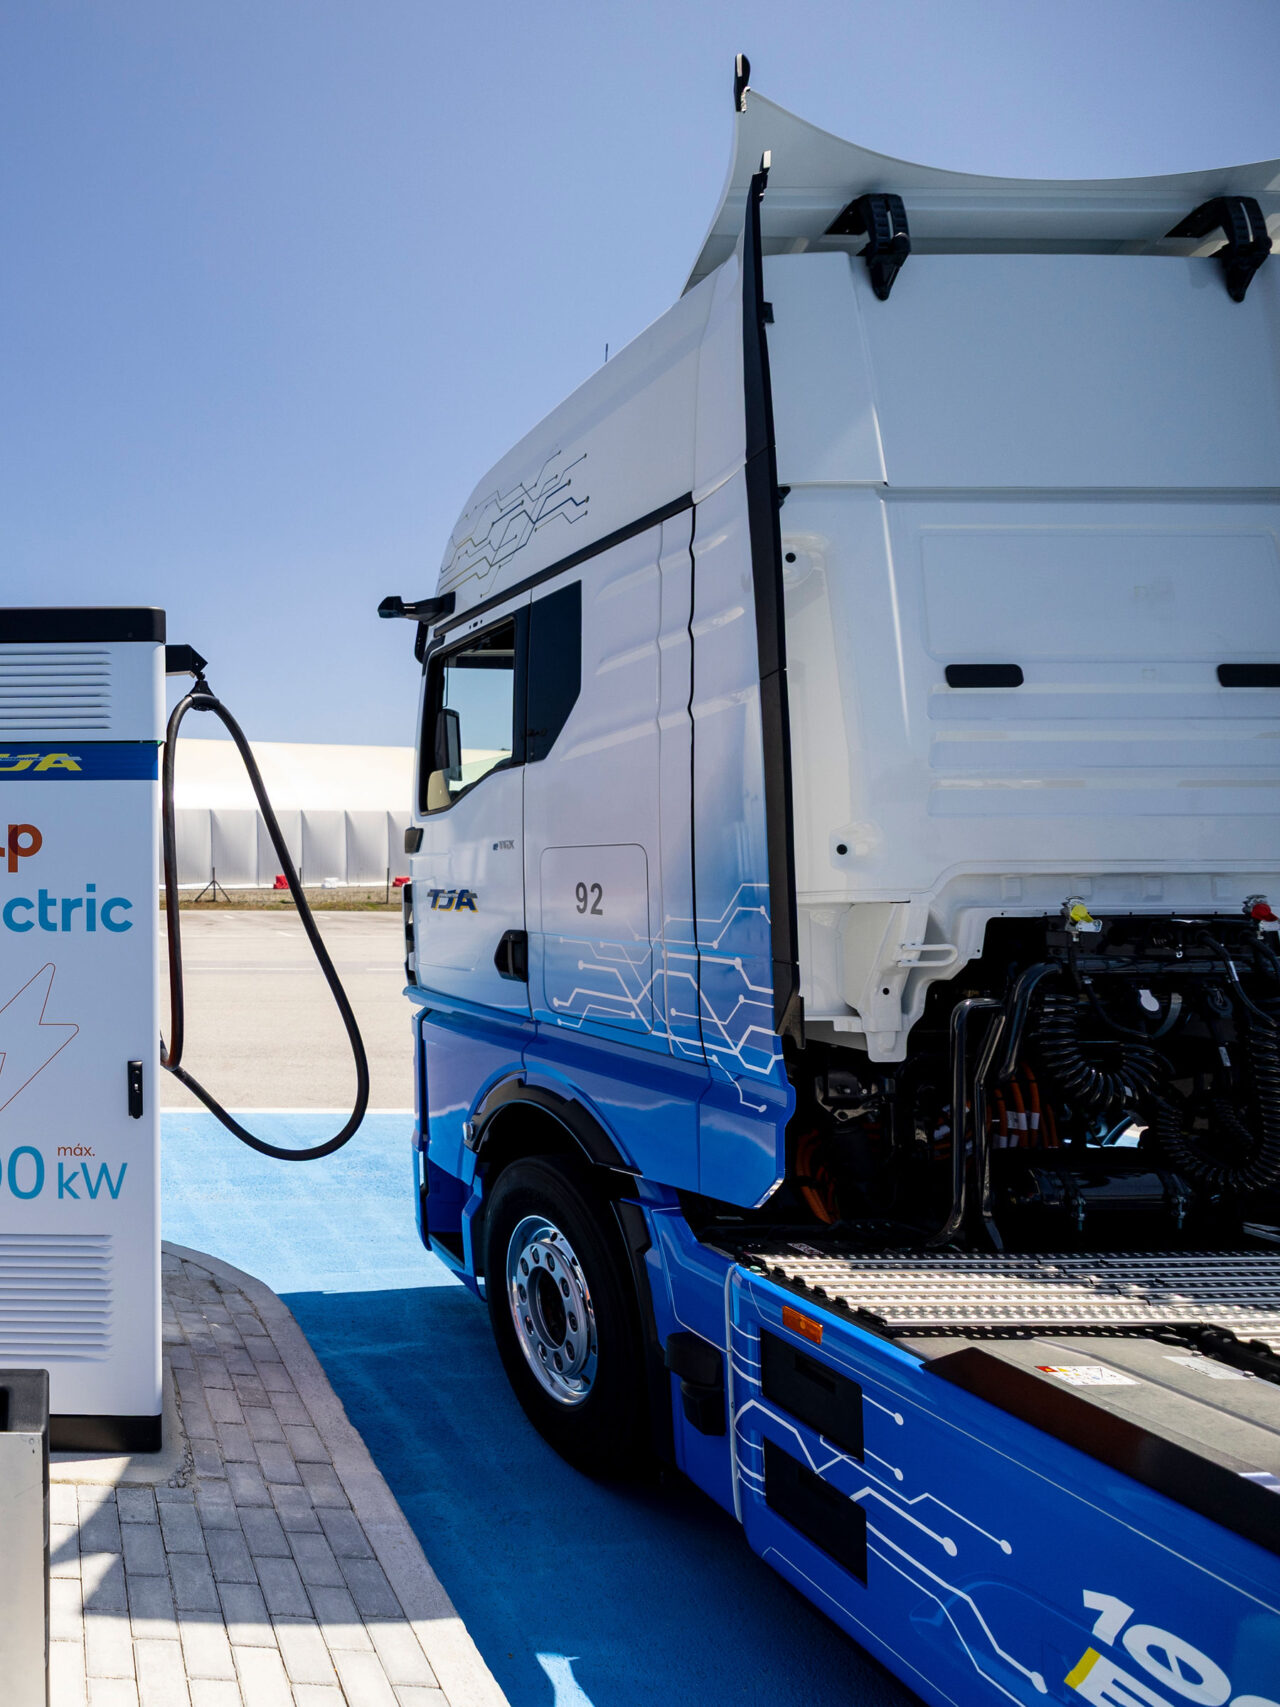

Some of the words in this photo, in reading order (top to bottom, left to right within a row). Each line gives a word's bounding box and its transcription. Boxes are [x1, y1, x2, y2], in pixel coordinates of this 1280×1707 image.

[428, 889, 479, 913] TJA
[575, 882, 603, 915] 92
[57, 1143, 96, 1157] máx.
[57, 1162, 128, 1200] kW
[1082, 1589, 1280, 1707] 10
